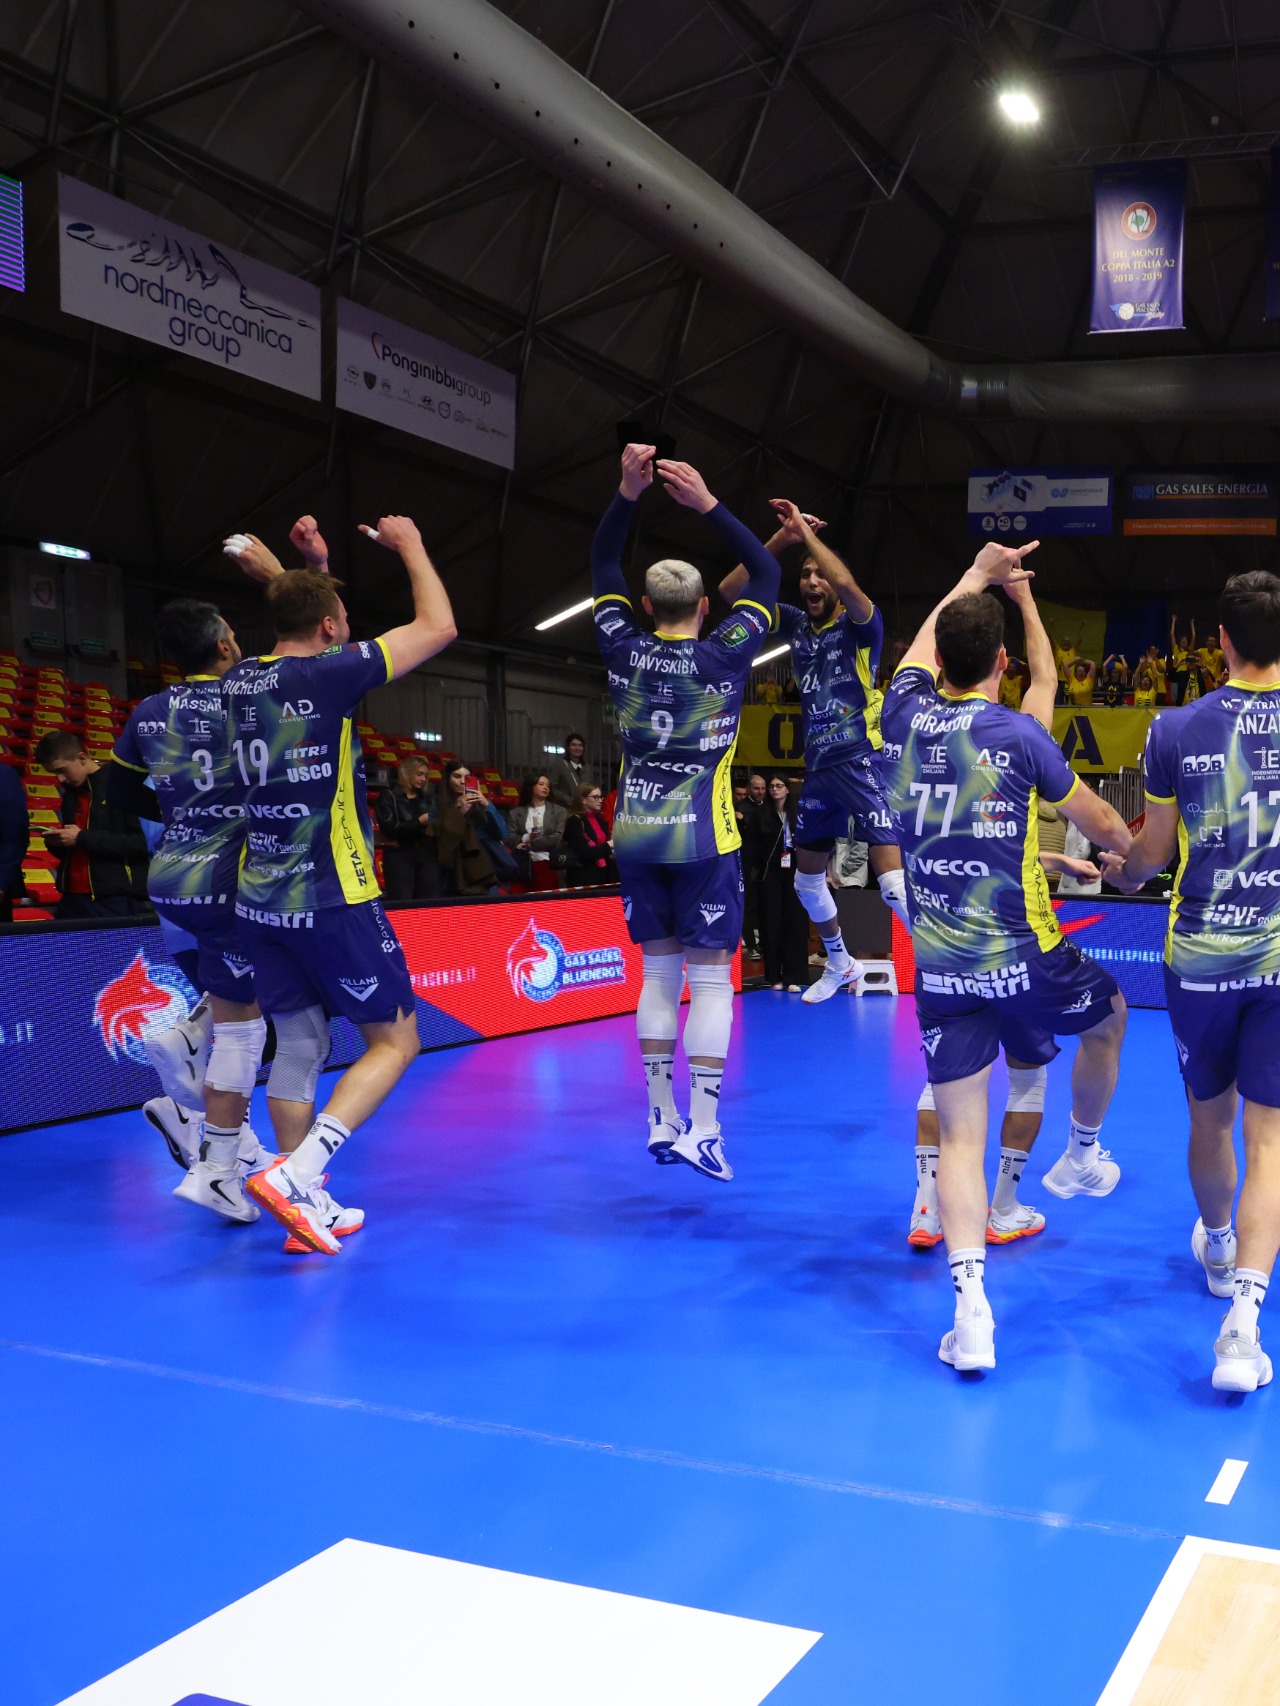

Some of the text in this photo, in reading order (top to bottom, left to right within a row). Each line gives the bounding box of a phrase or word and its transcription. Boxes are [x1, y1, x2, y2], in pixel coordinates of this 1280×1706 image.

[1112, 247, 1165, 260] DEL MONTE
[1101, 259, 1175, 271] COPPA ITALIA A2
[1142, 271, 1163, 281] 2019
[104, 264, 292, 354] nordmeccanica
[169, 317, 241, 363] group
[1156, 483, 1268, 495] GAS SALES ENERGIA
[629, 650, 700, 675] DAVYSKIBA
[802, 673, 822, 694] 24
[169, 696, 222, 712] MASSAR
[278, 713, 321, 724] CONSULTING
[650, 710, 674, 749] 9
[699, 731, 735, 752] USCO
[192, 749, 214, 792] 3
[232, 738, 269, 787] 19
[287, 762, 332, 783] USCO
[251, 803, 311, 819] VECA
[910, 782, 958, 838] 77
[979, 801, 1005, 813] ITR
[868, 809, 893, 829] 24
[972, 820, 1018, 839] USCO
[917, 857, 990, 877] VECA
[564, 949, 621, 968] GAS SALES
[338, 976, 378, 987] VILLANI
[409, 966, 477, 987] PIACENZA.IT
[562, 965, 622, 986] BLUENERGY
[944, 972, 1031, 999] nastri
[650, 1062, 659, 1077] nine
[919, 1153, 927, 1173] nine
[1002, 1155, 1013, 1175] nine
[965, 1257, 974, 1278] nine
[1241, 1279, 1253, 1297] nine
